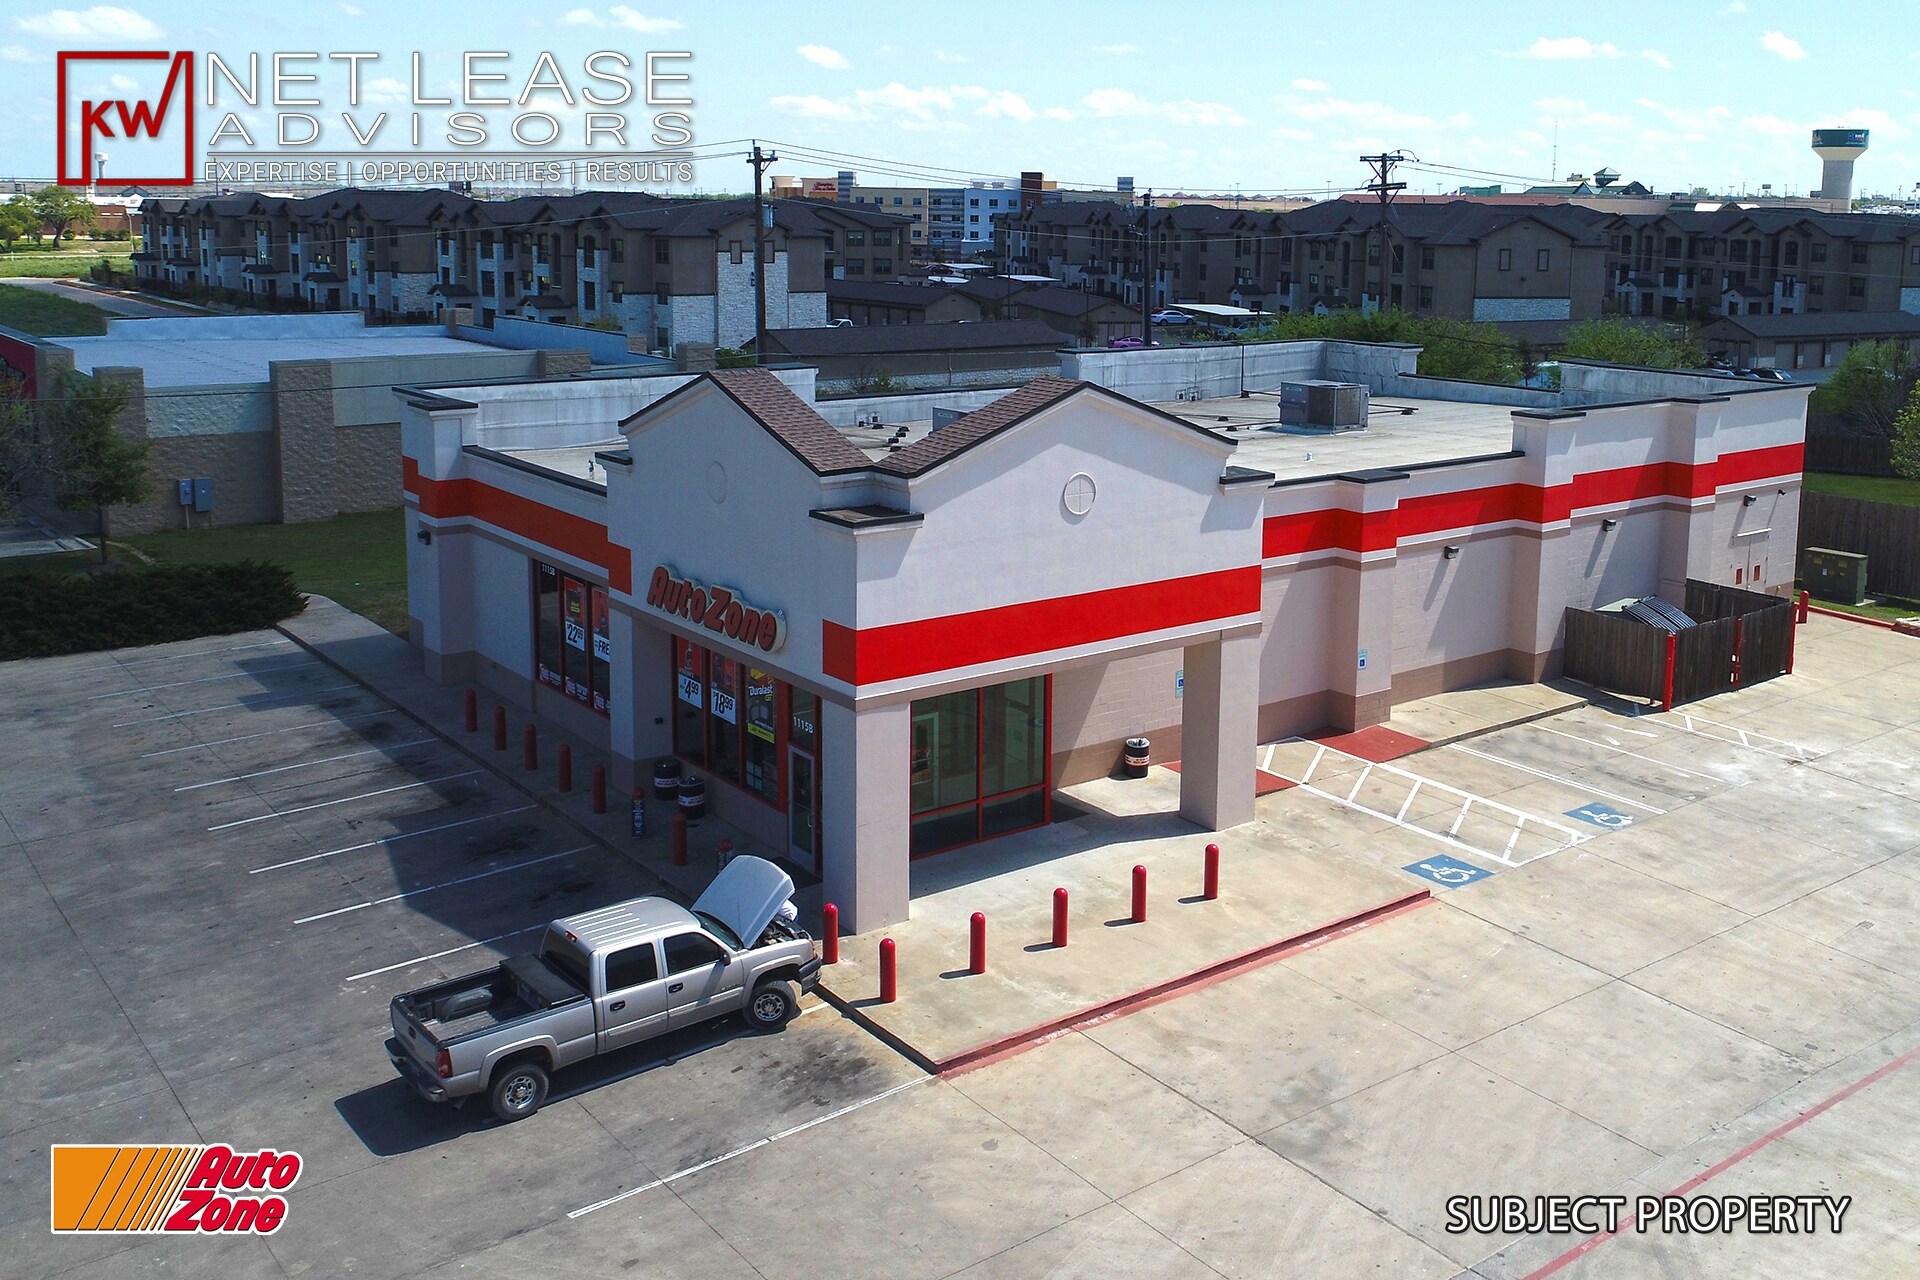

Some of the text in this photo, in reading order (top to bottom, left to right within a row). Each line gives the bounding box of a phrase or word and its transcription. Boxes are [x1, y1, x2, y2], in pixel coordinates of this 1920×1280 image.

[647, 564, 778, 651] AutoZone
[598, 640, 610, 655] FRE
[793, 716, 814, 733] 1115B
